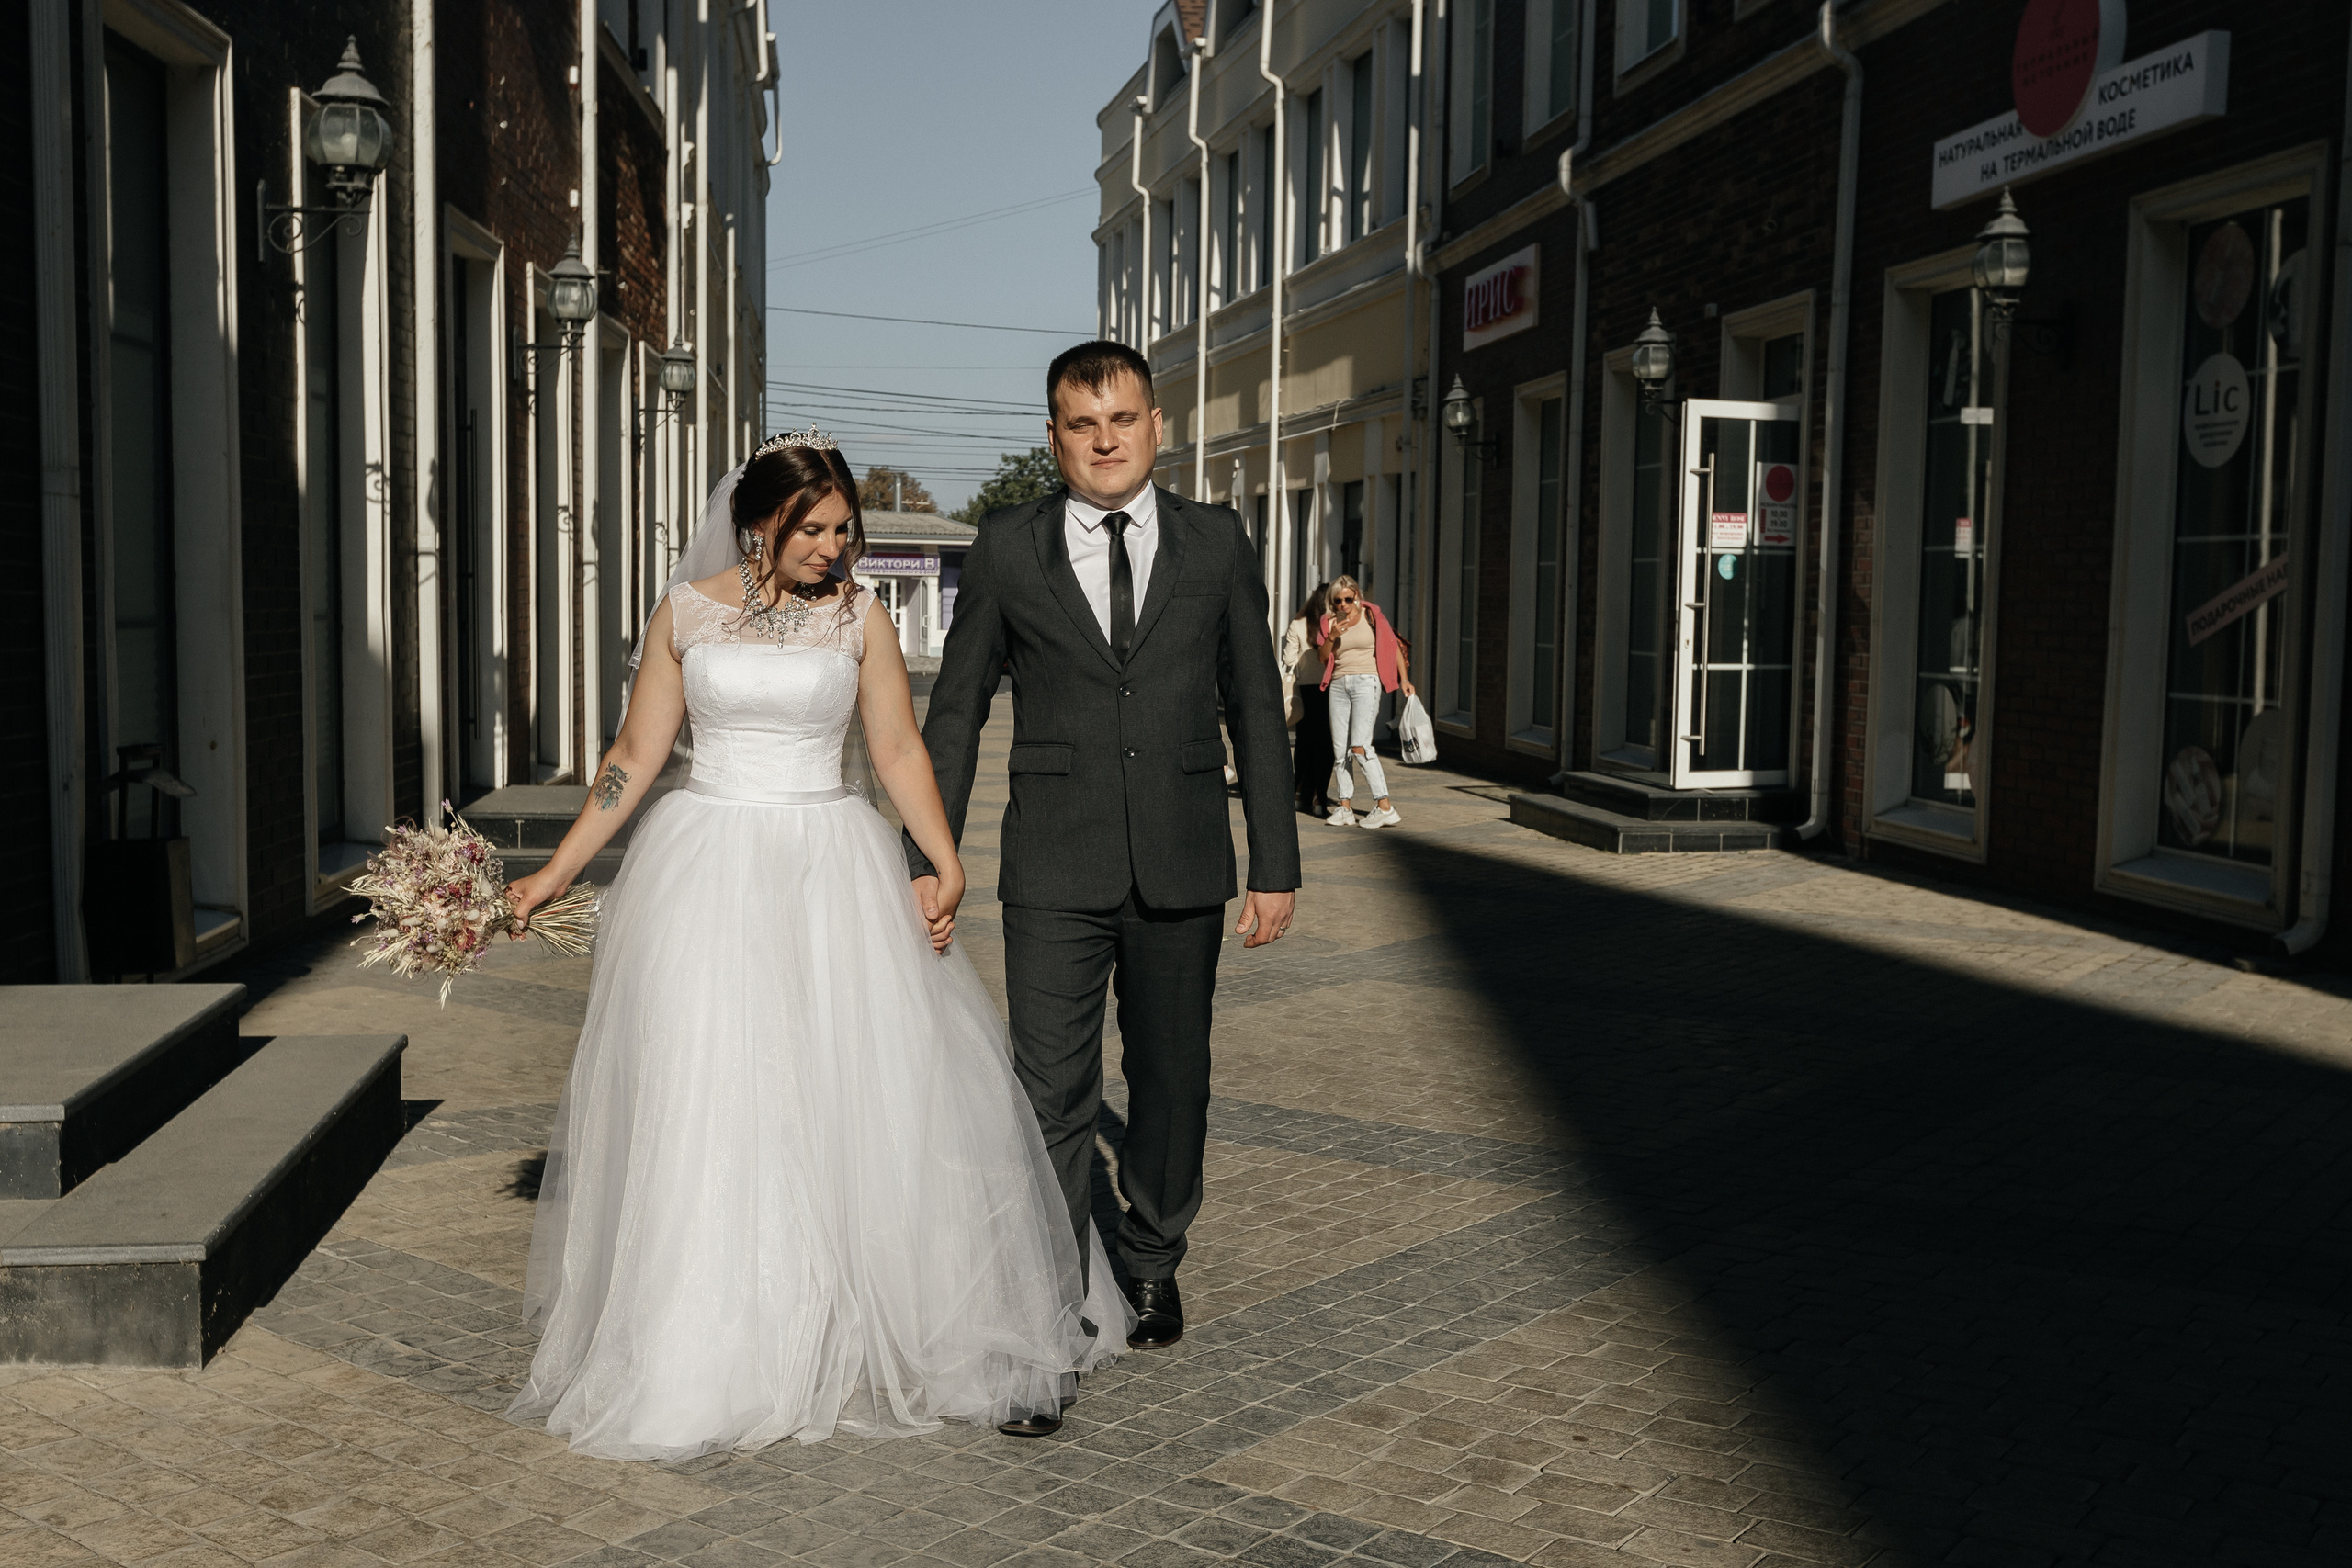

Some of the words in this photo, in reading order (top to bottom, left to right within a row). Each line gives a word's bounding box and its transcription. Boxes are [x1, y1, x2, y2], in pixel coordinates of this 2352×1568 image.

[1939, 118, 2023, 167] НАТУРАЛЬНАЯ
[2098, 51, 2194, 106] КОСМЕТИКА
[1980, 160, 1998, 182] НА
[2003, 121, 2094, 173] ТЕРМАЛЬНОЙ
[2097, 108, 2136, 140] ВОДЕ
[1465, 268, 1516, 332] ИРИС
[2195, 380, 2239, 416] Lic
[2190, 579, 2267, 636] ПОДАРОЧНЫЕ
